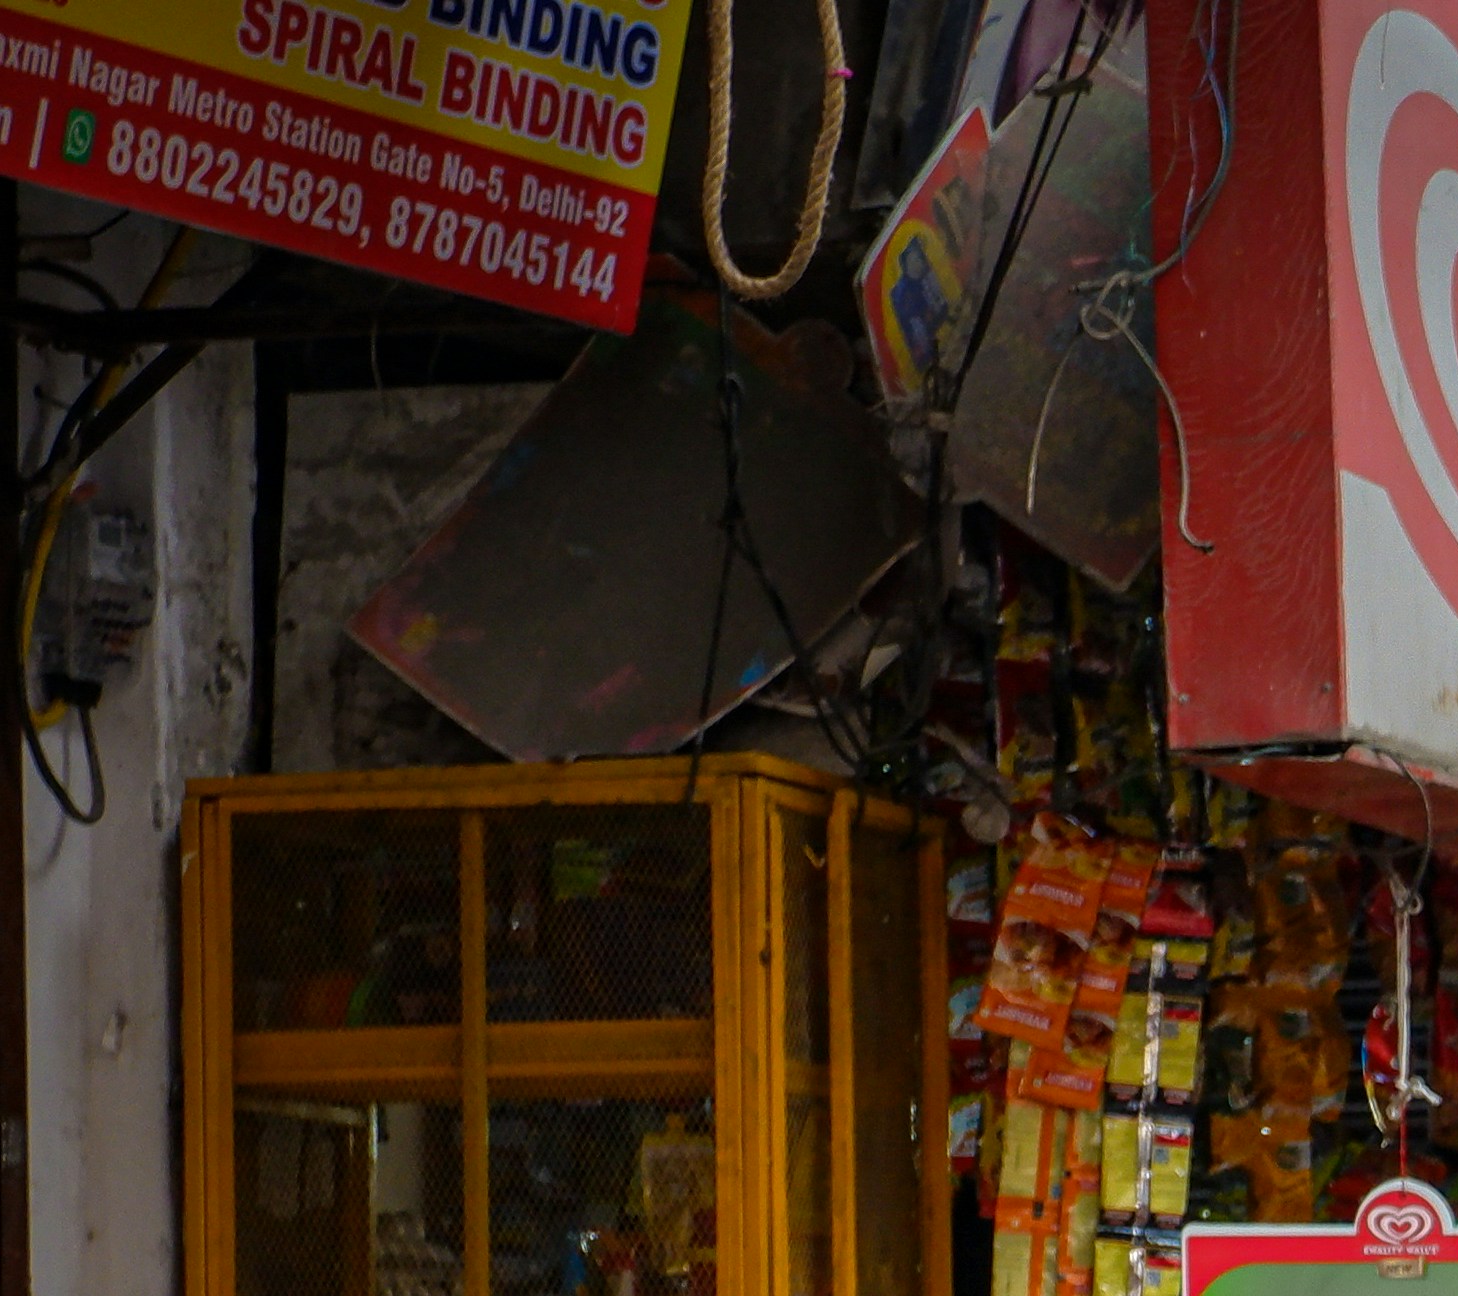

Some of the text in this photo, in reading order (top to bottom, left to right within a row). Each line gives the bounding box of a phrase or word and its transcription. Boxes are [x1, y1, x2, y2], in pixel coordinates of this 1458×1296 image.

[68, 48, 160, 107] Nagar
[167, 73, 253, 134] Metro
[262, 101, 361, 164] Station
[370, 133, 433, 182] Gate
[440, 153, 510, 212] No-5,
[519, 175, 629, 238] Delhi-92
[238, 0, 648, 169] SPIRAL BINDING
[106, 120, 370, 248] 8802245829,
[385, 194, 618, 302] 8787045144
